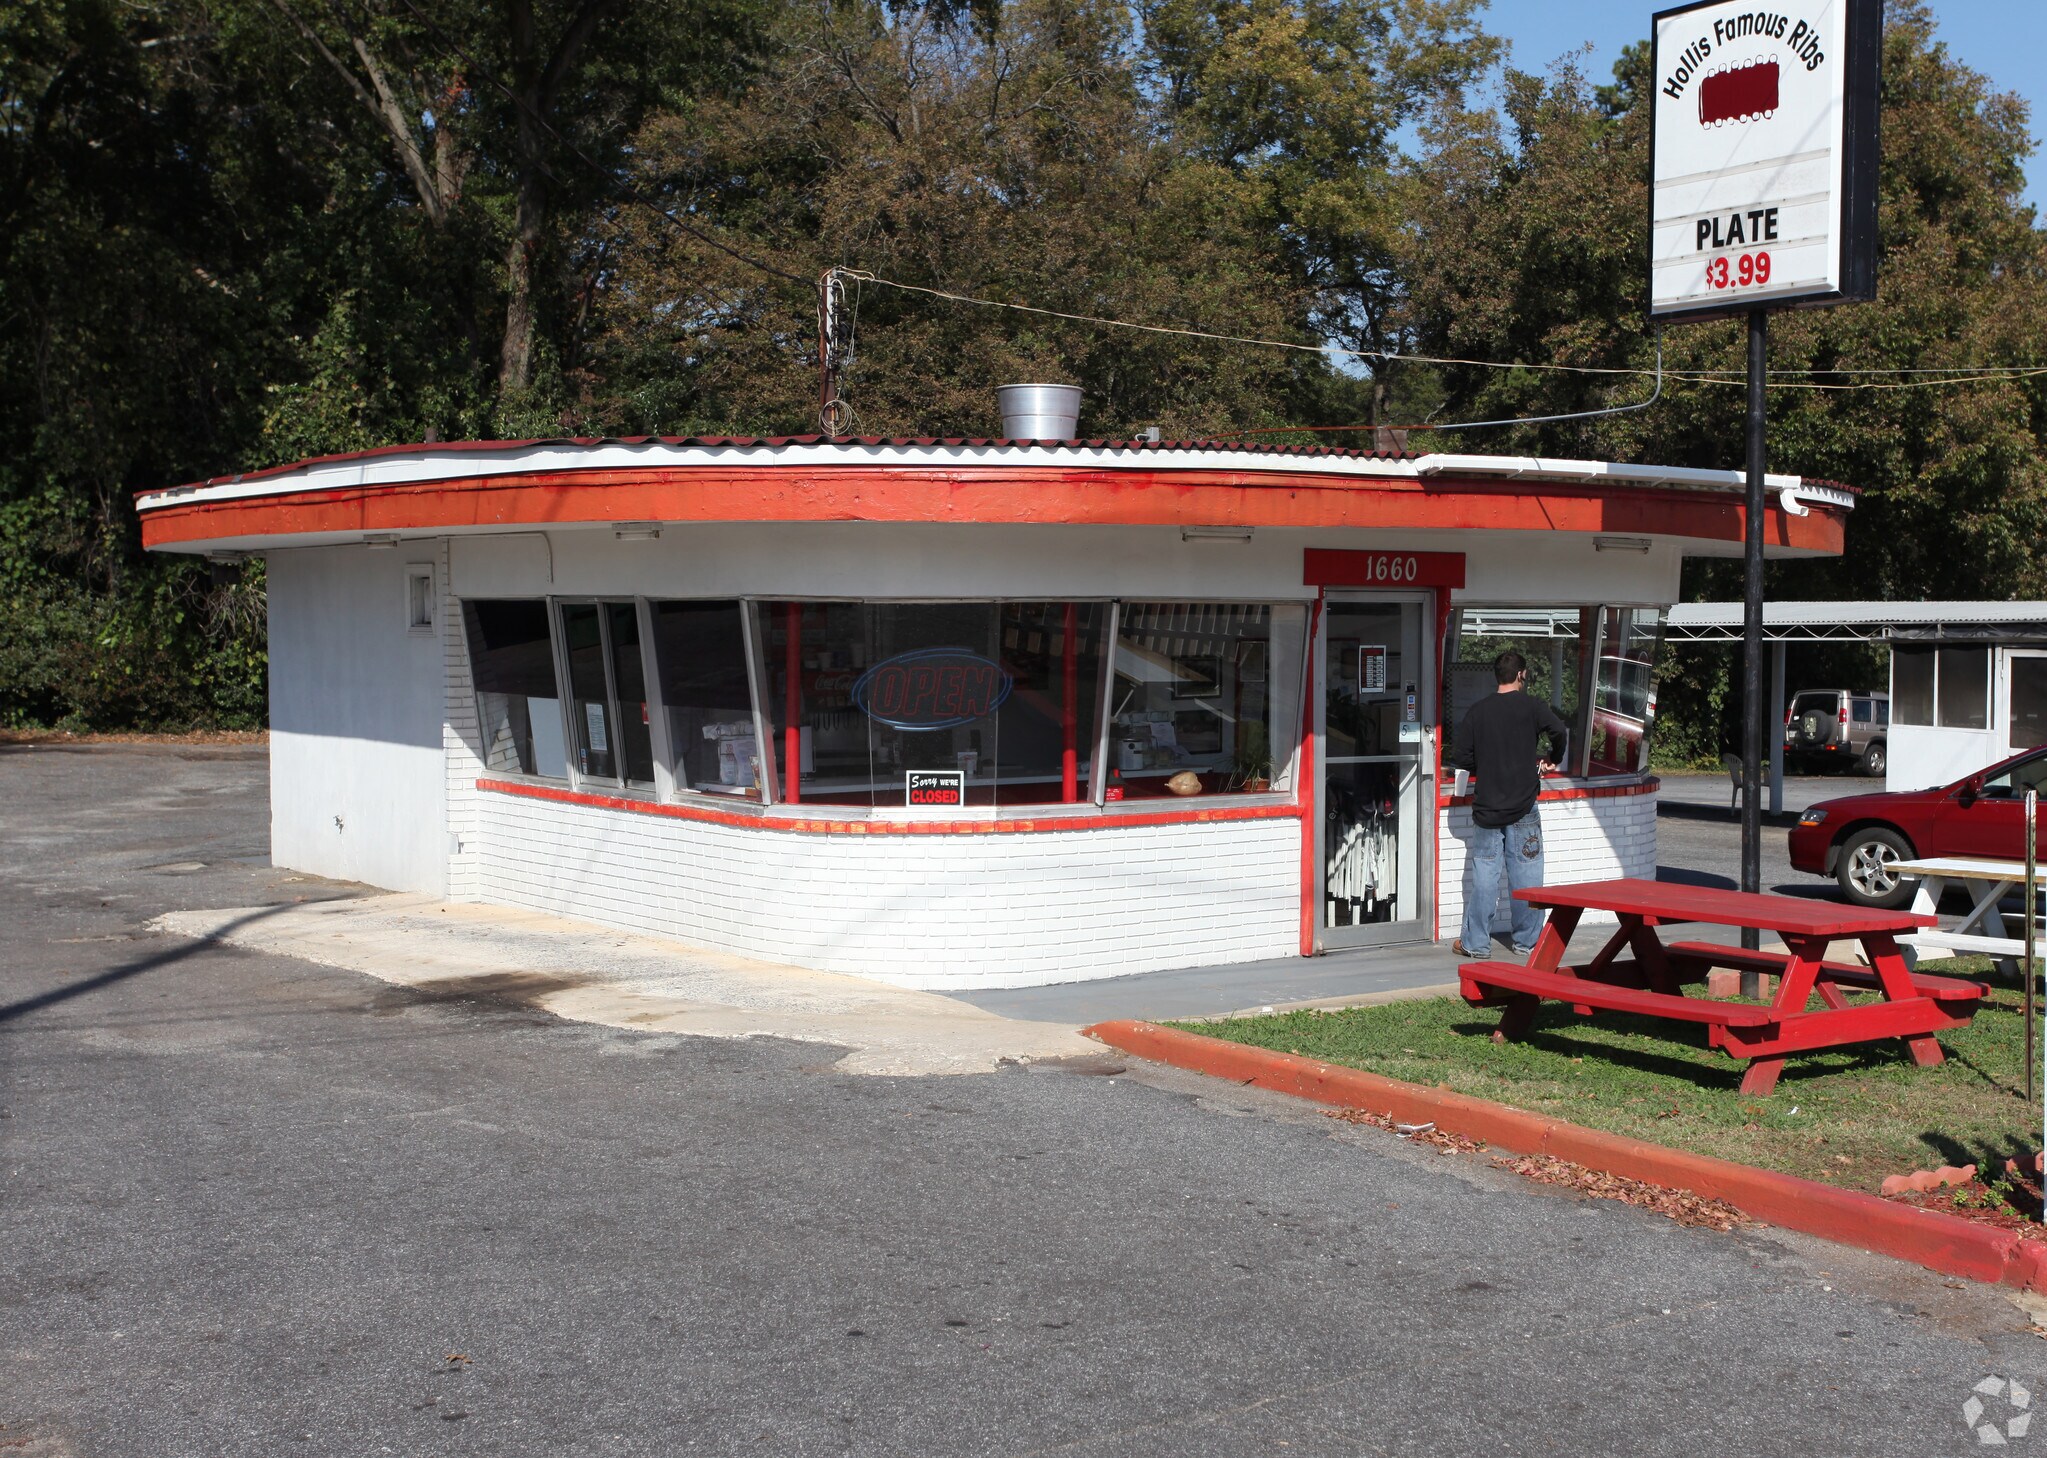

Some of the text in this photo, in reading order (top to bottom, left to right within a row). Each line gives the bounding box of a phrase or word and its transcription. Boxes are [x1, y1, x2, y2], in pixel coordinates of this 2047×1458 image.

[1663, 11, 1825, 100] Hollis Famous Ribs
[1697, 207, 1778, 250] PLATE
[1706, 251, 1771, 290] $3.99
[1366, 555, 1417, 582] 1660
[875, 667, 994, 715] OPEN
[911, 775, 938, 788] Sorry
[911, 789, 959, 803] CLOSED
